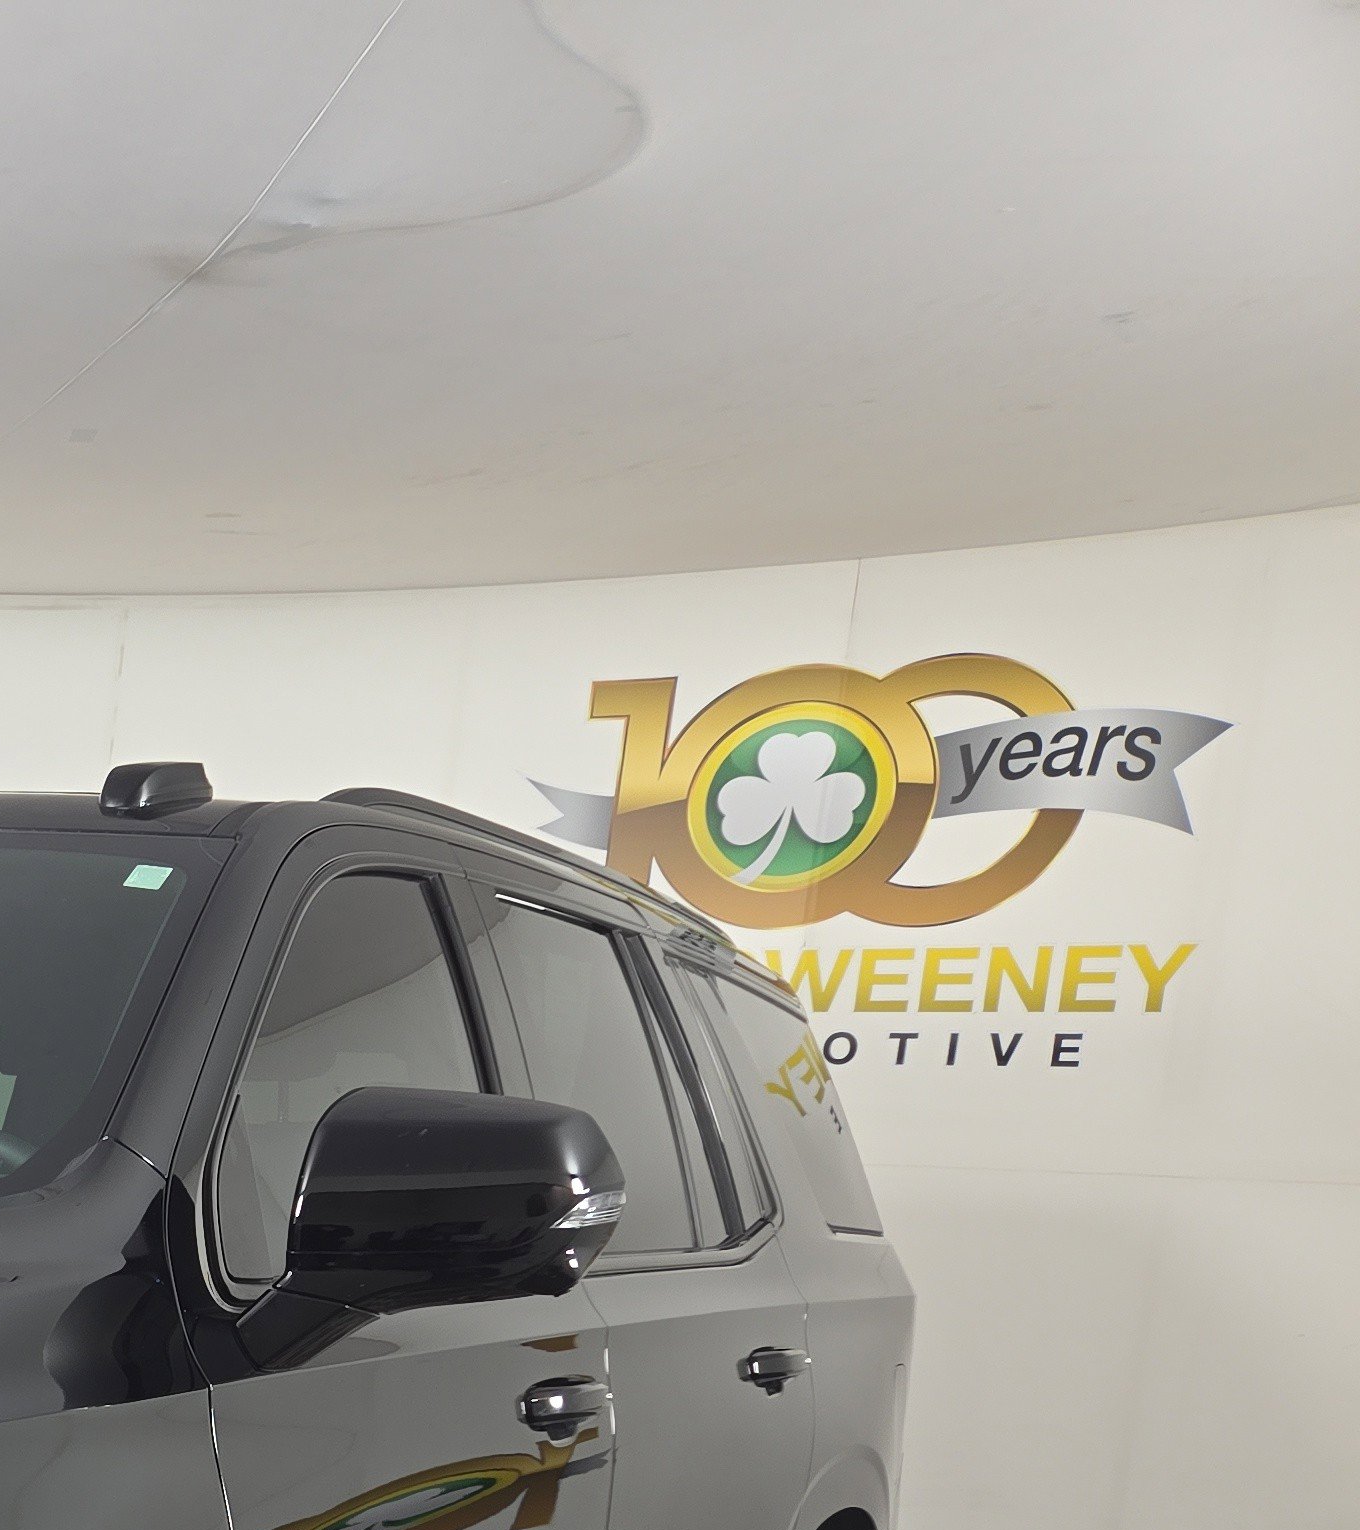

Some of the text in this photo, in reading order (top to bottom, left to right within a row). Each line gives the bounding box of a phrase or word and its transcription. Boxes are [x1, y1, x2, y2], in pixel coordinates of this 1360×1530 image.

[949, 723, 1162, 806] years
[764, 943, 1198, 1014] WEENEY
[822, 1031, 1085, 1068] OTIVE
